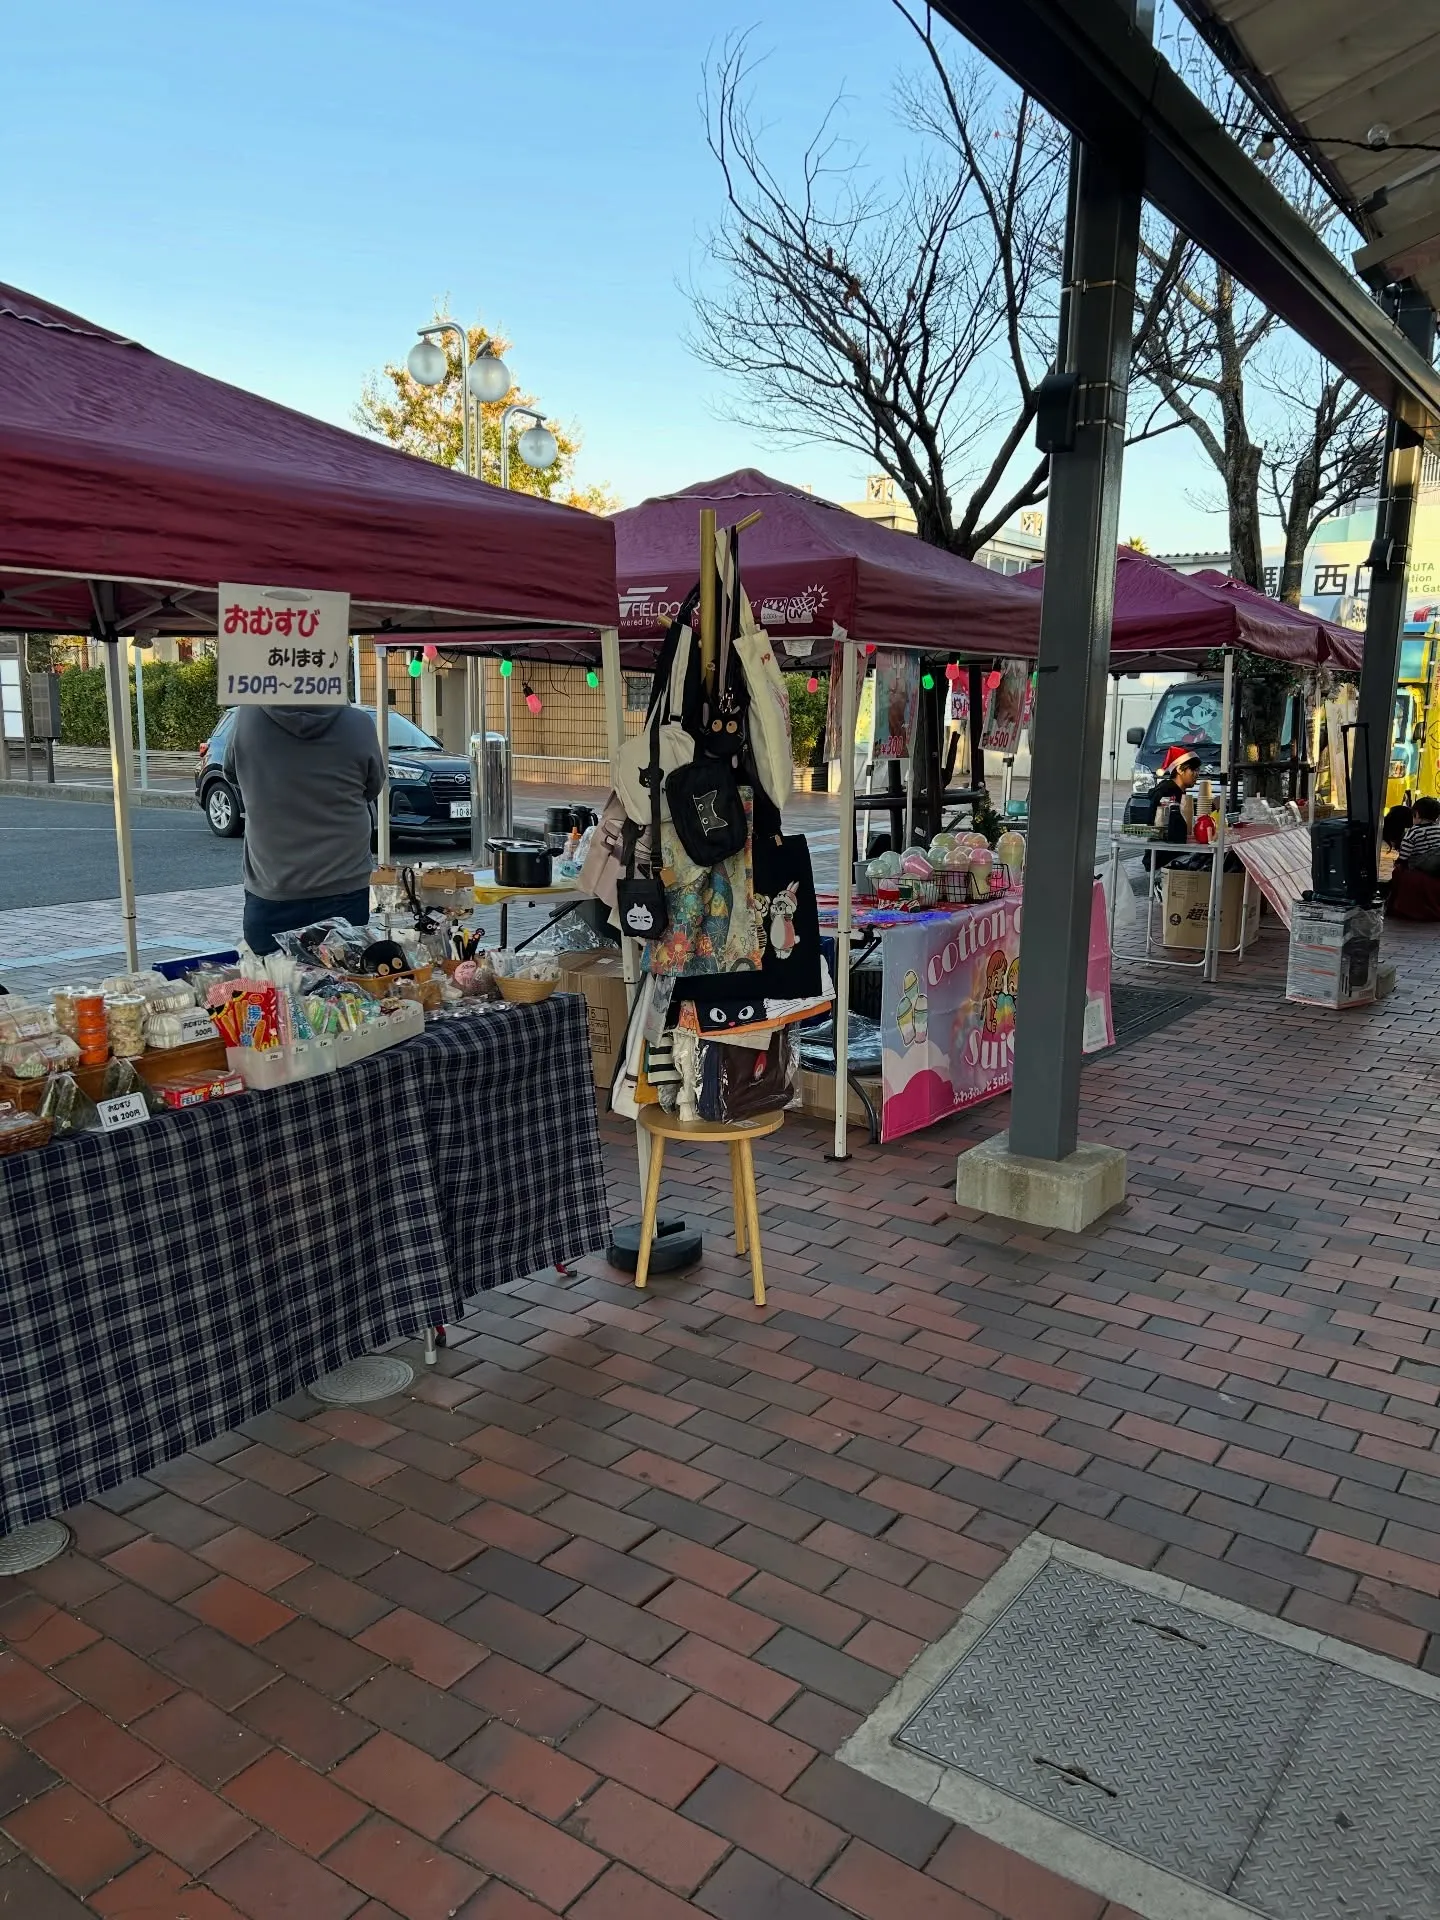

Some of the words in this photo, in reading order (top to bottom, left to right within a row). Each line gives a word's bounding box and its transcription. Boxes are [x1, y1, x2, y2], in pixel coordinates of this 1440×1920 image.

[1409, 562, 1435, 572] UTA
[1408, 573, 1432, 583] tion
[1422, 584, 1440, 593] Gat
[631, 601, 701, 617] FIELDOR
[223, 603, 321, 638] おむすび
[620, 617, 643, 627] wered
[927, 909, 1006, 987] cotton
[183, 1018, 212, 1030] おむすびセ
